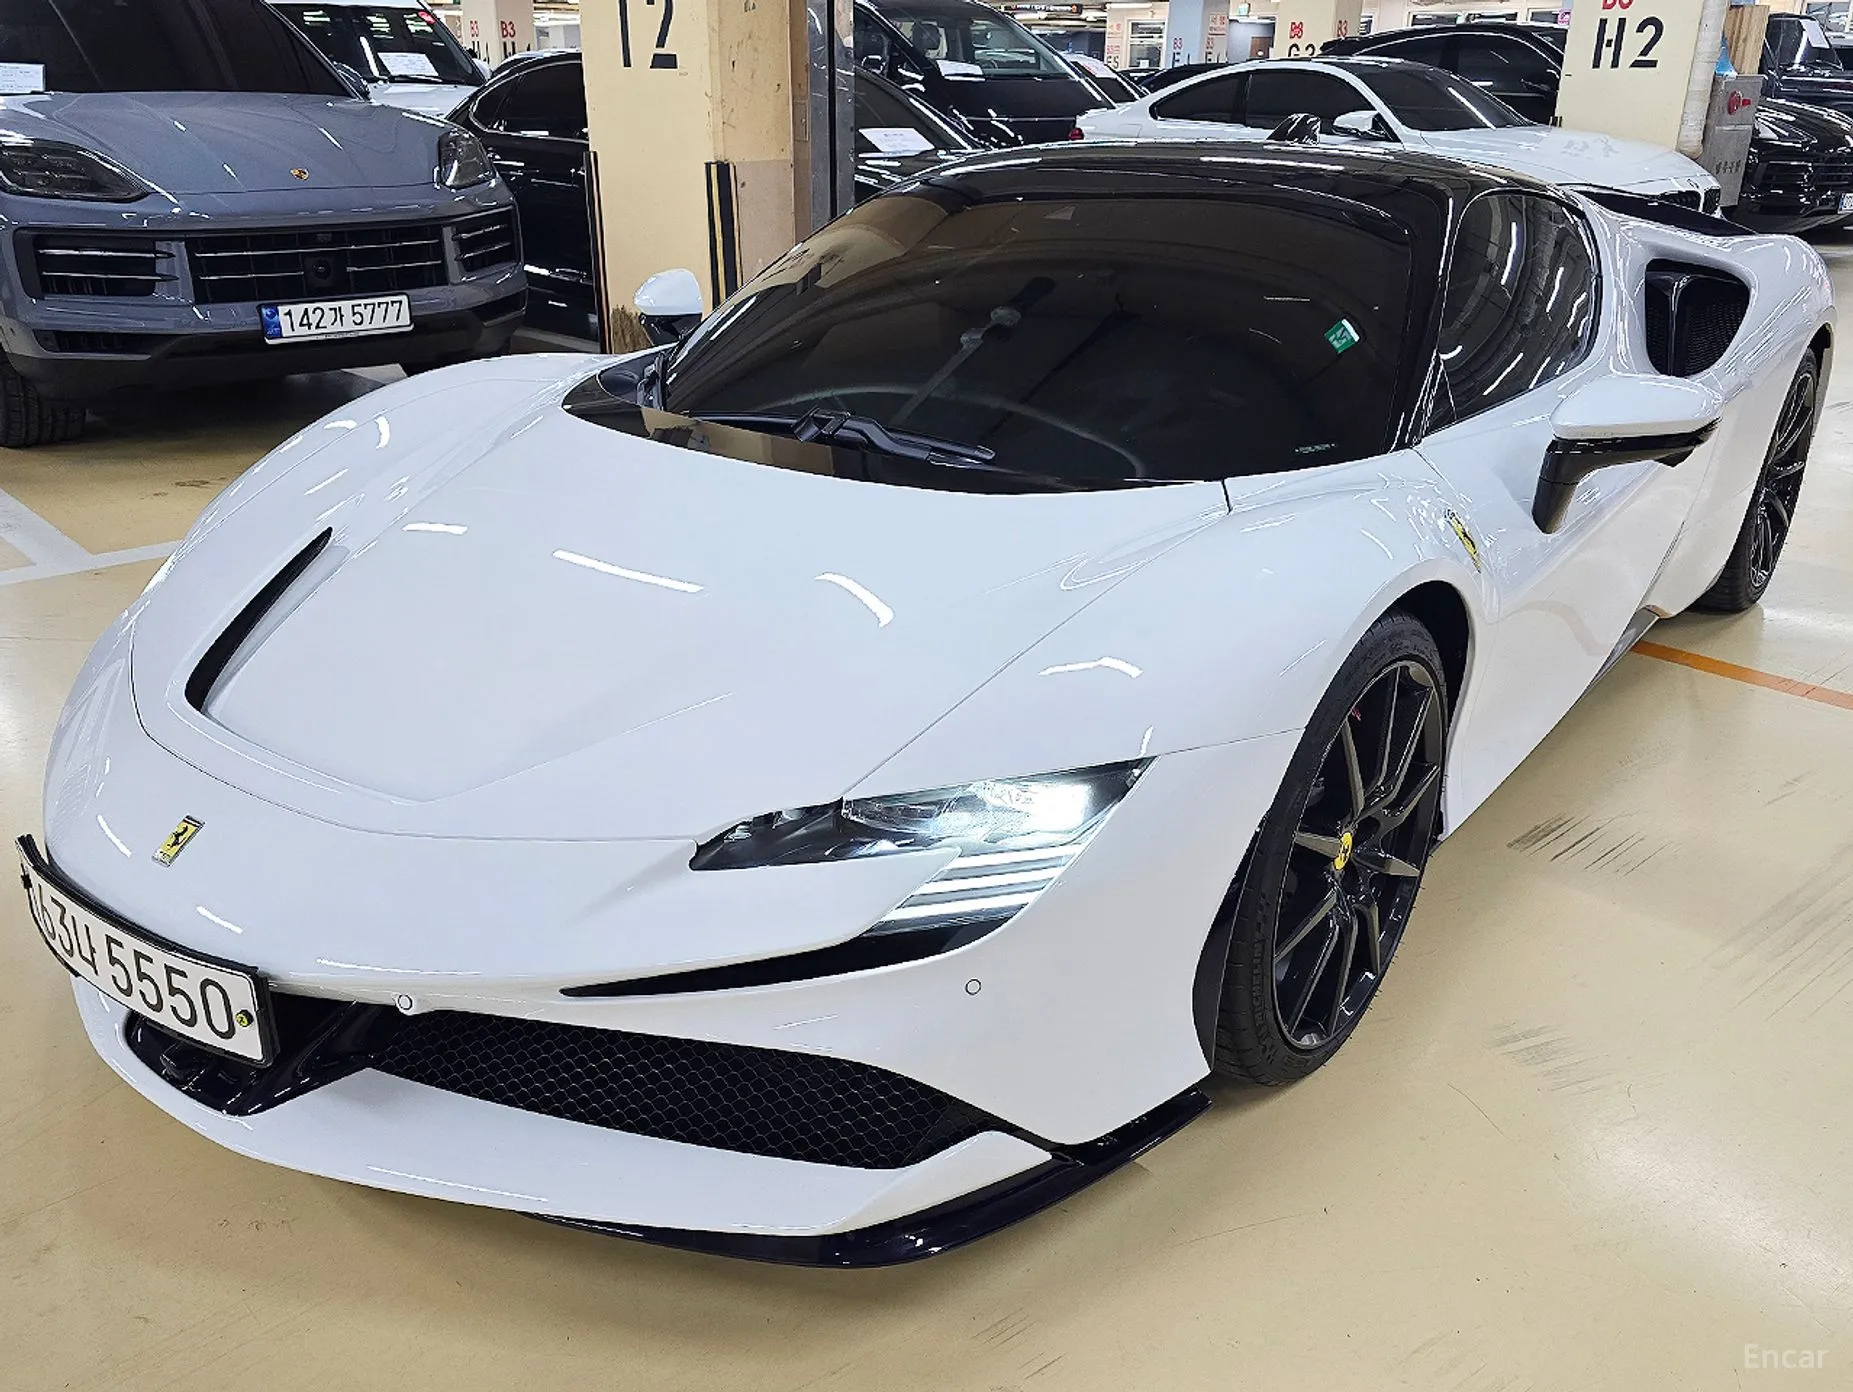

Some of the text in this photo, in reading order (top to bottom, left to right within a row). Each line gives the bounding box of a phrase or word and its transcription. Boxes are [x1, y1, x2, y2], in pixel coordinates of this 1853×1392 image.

[500, 20, 516, 38] B3
[1592, 16, 1664, 69] H2
[284, 300, 403, 332] 142가 5777
[105, 934, 236, 1040] 5550
